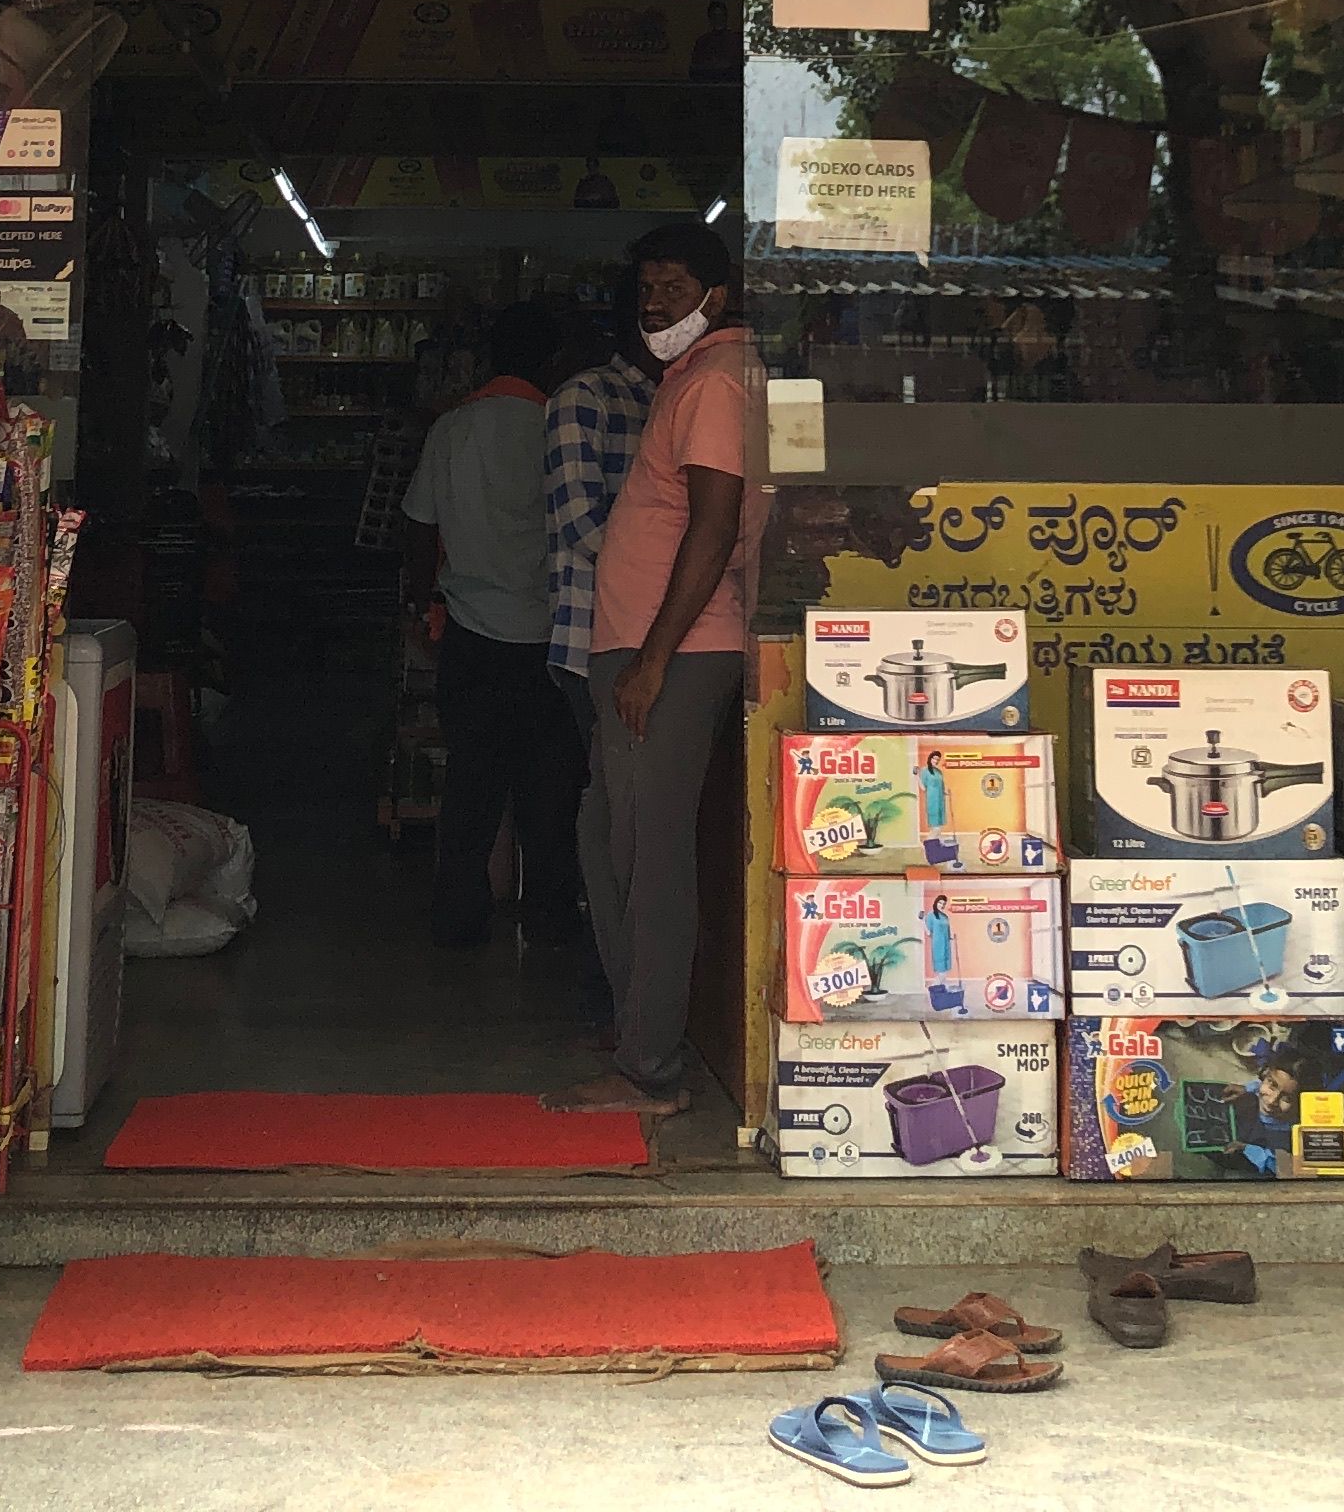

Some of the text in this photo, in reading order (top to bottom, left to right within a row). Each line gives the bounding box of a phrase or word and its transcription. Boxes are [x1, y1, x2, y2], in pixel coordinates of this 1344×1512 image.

[800, 160, 915, 177] SODEXO CARDS
[798, 182, 916, 199] ACCEPTED HERE
[32, 203, 67, 216] RuPay
[38, 231, 63, 240] HERE
[1272, 513, 1316, 529] SINCE
[1293, 600, 1339, 613] CYCLE
[831, 624, 867, 636] NANDI
[1128, 684, 1174, 697] NANDI
[827, 716, 846, 727] Litre
[820, 749, 875, 775] Gala
[1125, 839, 1146, 849] Litre
[1089, 872, 1172, 891] Greenchef
[1294, 888, 1338, 900] SMART
[824, 893, 881, 920] Gala
[1311, 900, 1340, 912] MOP
[798, 1029, 882, 1050] Greenchef
[1108, 1034, 1159, 1056] Gala
[996, 1043, 1049, 1057] SMART
[839, 1066, 859, 1075] Clean
[1016, 1059, 1050, 1072] MOP
[794, 1074, 863, 1085] Starts at floor level
[1116, 1072, 1154, 1089] QUICK
[1122, 1087, 1152, 1103] SPIN
[1123, 1099, 1158, 1116] MOP
[1021, 1112, 1042, 1125] 360
